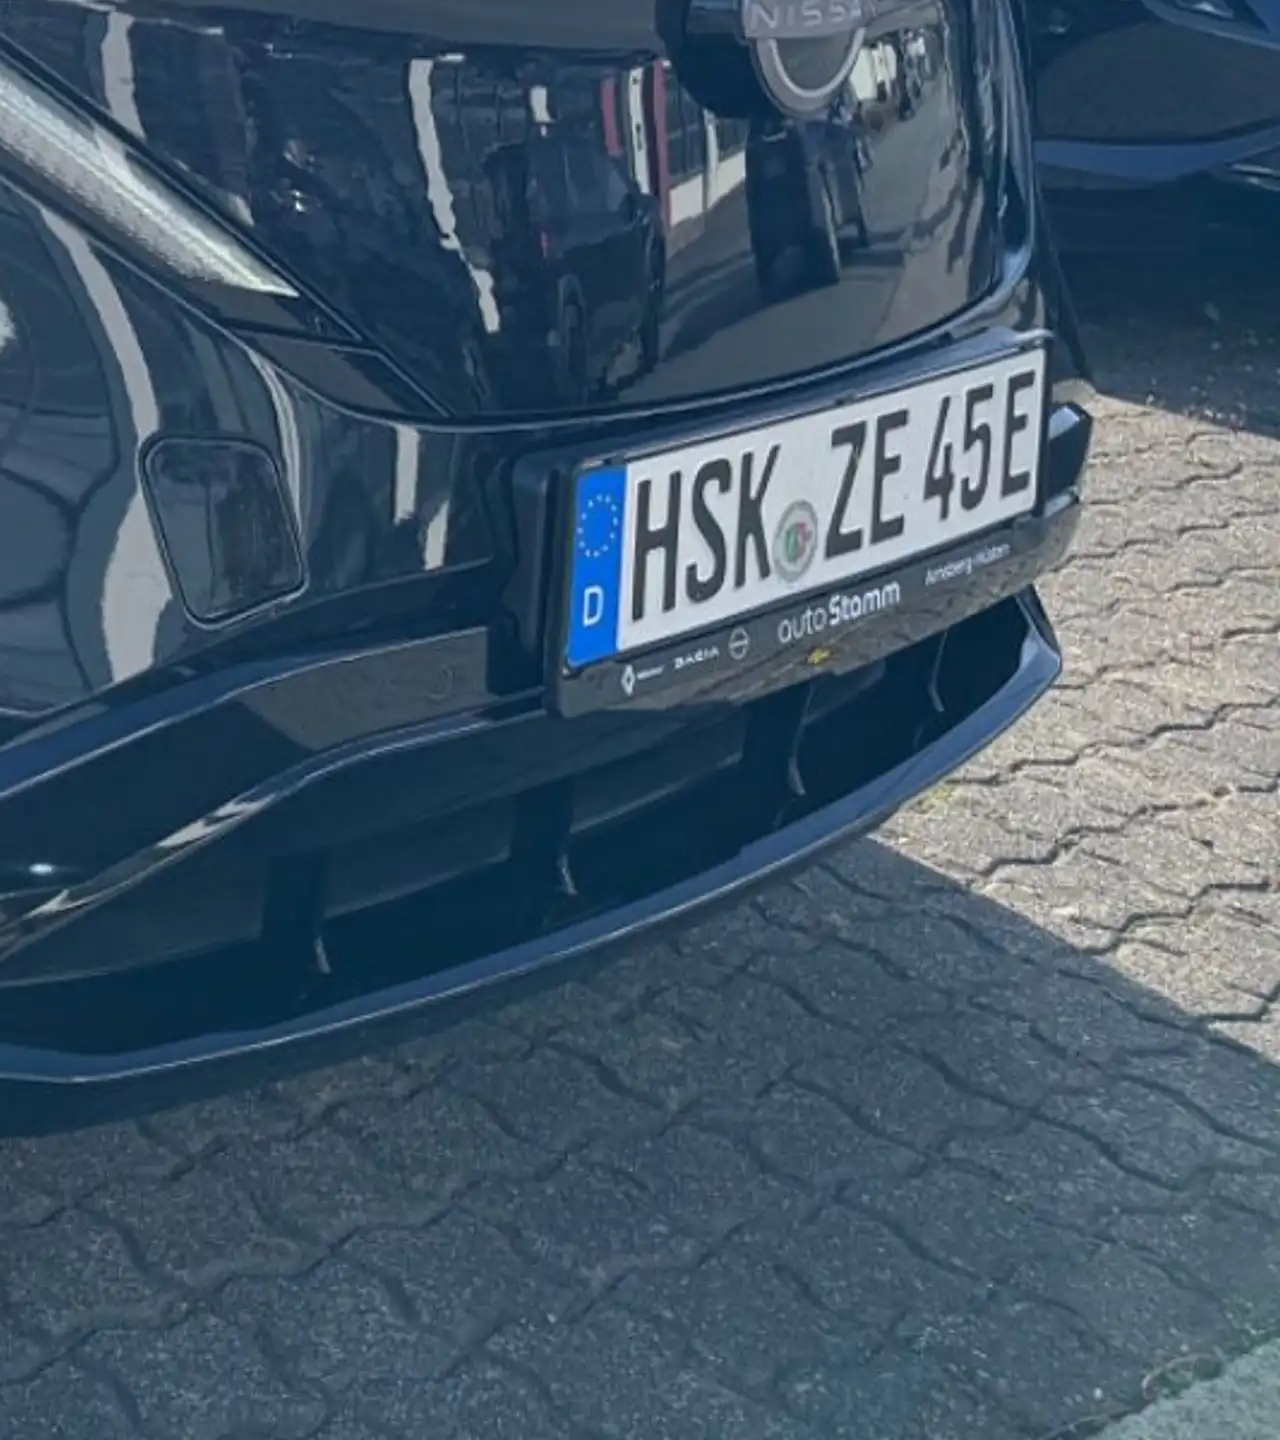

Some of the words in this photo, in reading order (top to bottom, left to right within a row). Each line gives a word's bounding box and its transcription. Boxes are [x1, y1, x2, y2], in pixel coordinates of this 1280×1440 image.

[630, 444, 781, 622] HSK
[825, 409, 910, 560] ZE
[923, 370, 1037, 522] 45E
[582, 585, 604, 627] D
